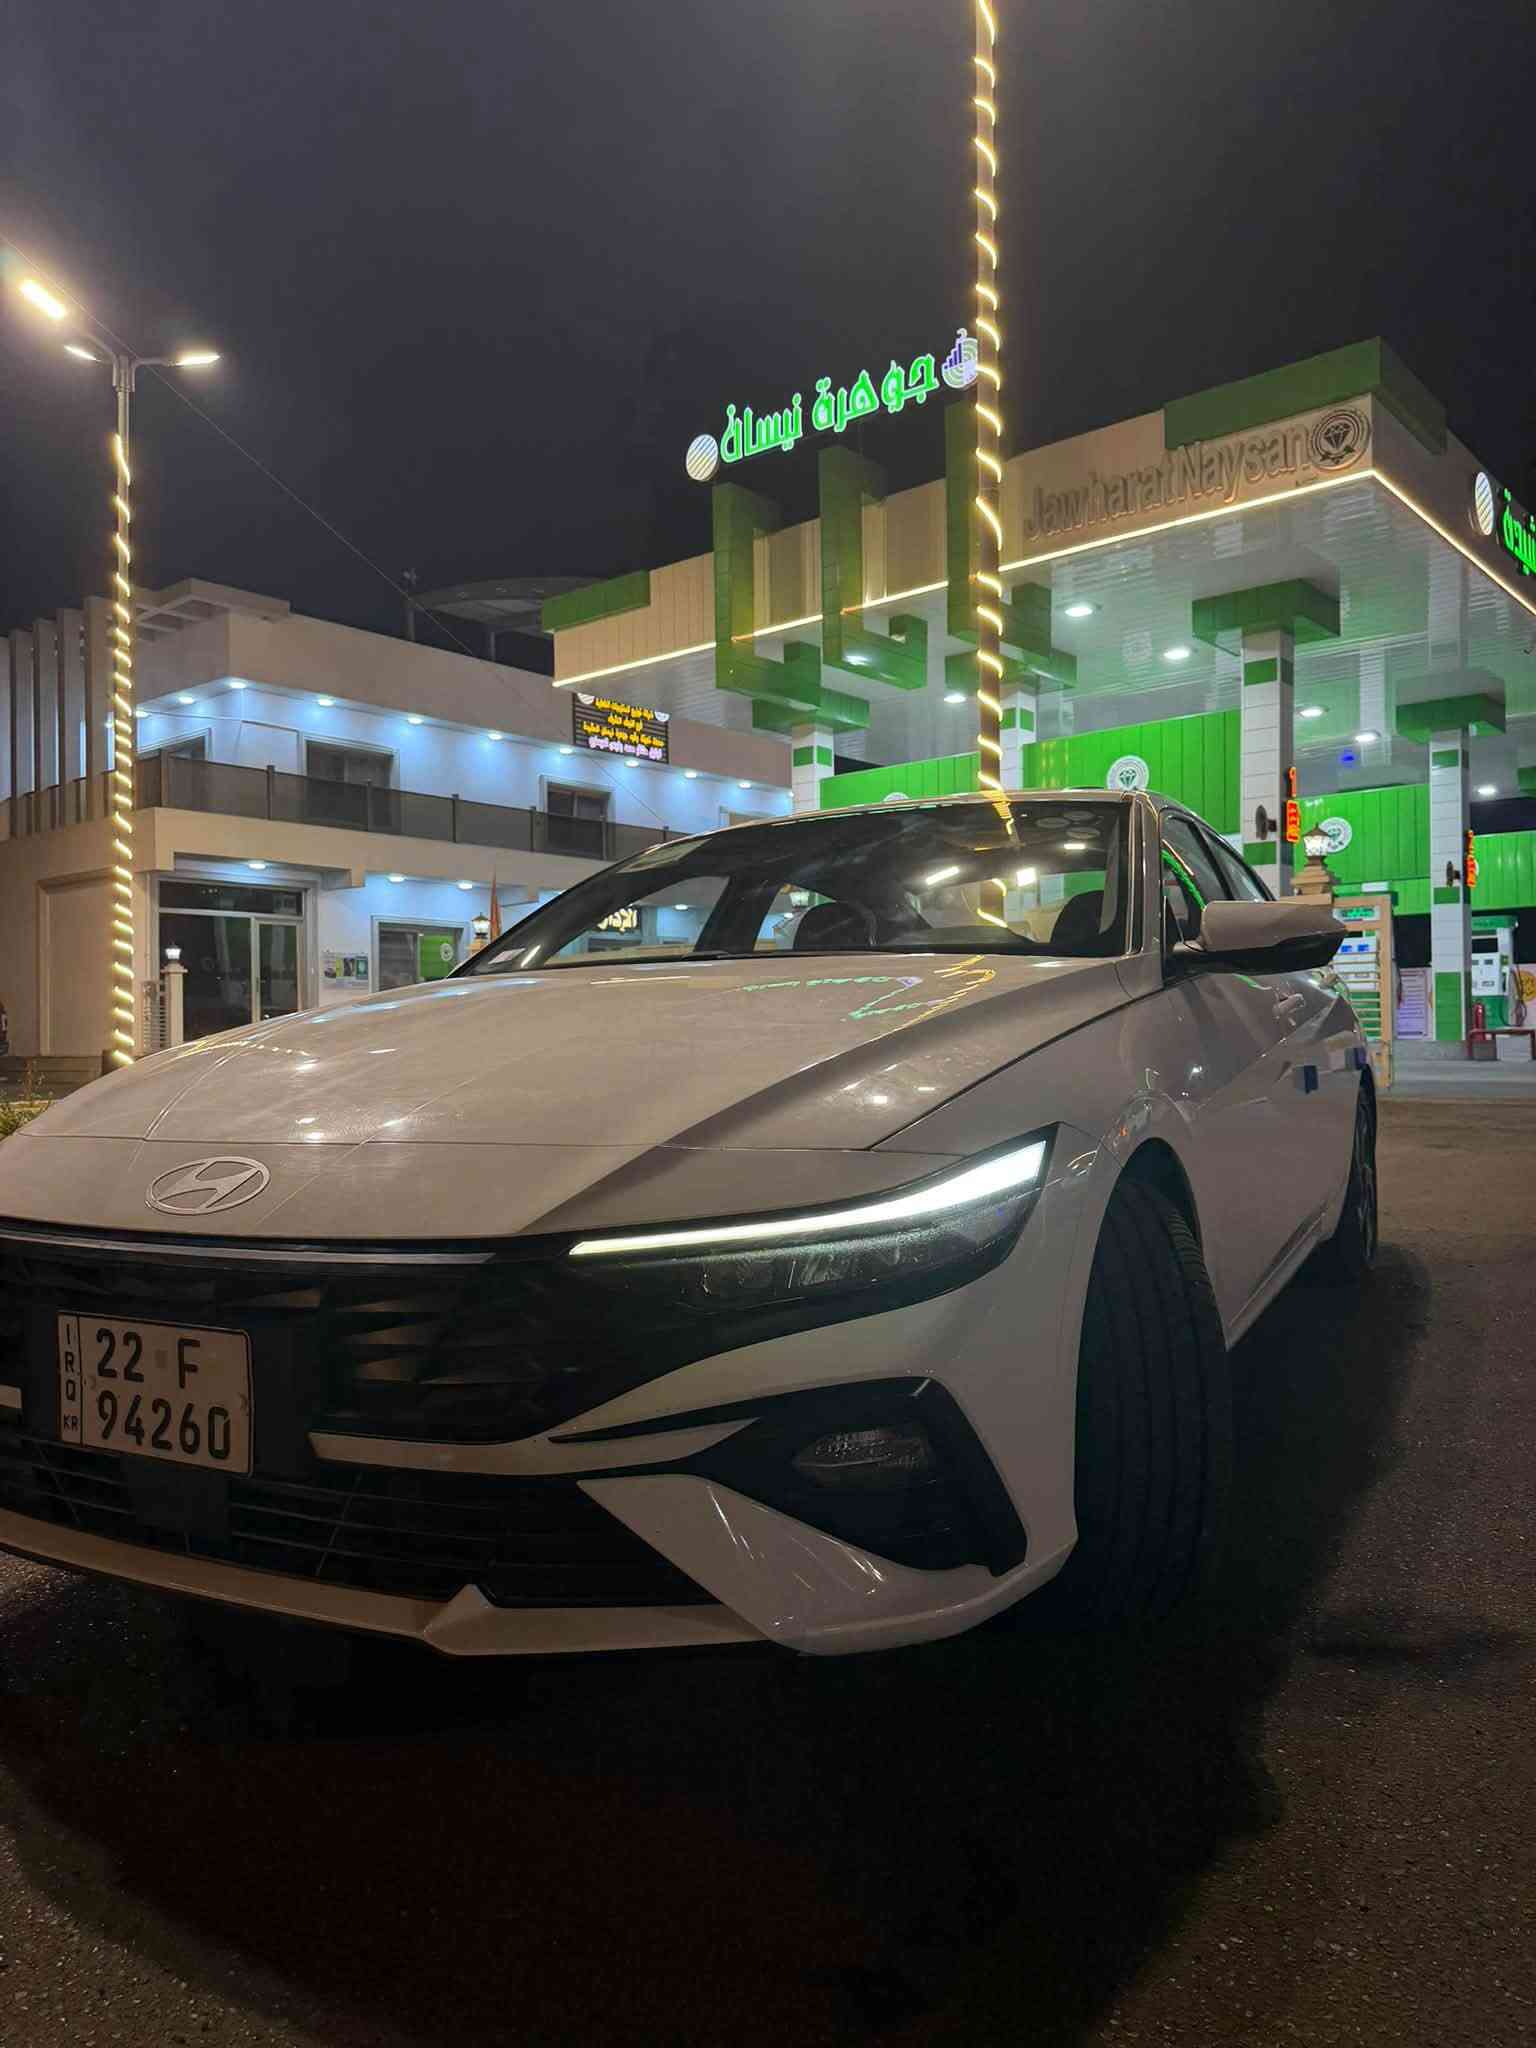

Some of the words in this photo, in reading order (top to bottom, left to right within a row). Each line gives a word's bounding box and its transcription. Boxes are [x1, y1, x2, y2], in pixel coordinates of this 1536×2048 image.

[720, 392, 803, 463] نيسان
[811, 352, 940, 433] جوهرة
[1024, 449, 1180, 541] Jawharat
[1180, 424, 1313, 503] Naysan
[64, 1323, 77, 1402] IRQ
[96, 1327, 145, 1383] 22
[177, 1337, 201, 1389] F
[63, 1413, 79, 1432] KR
[97, 1390, 231, 1460] 94260
